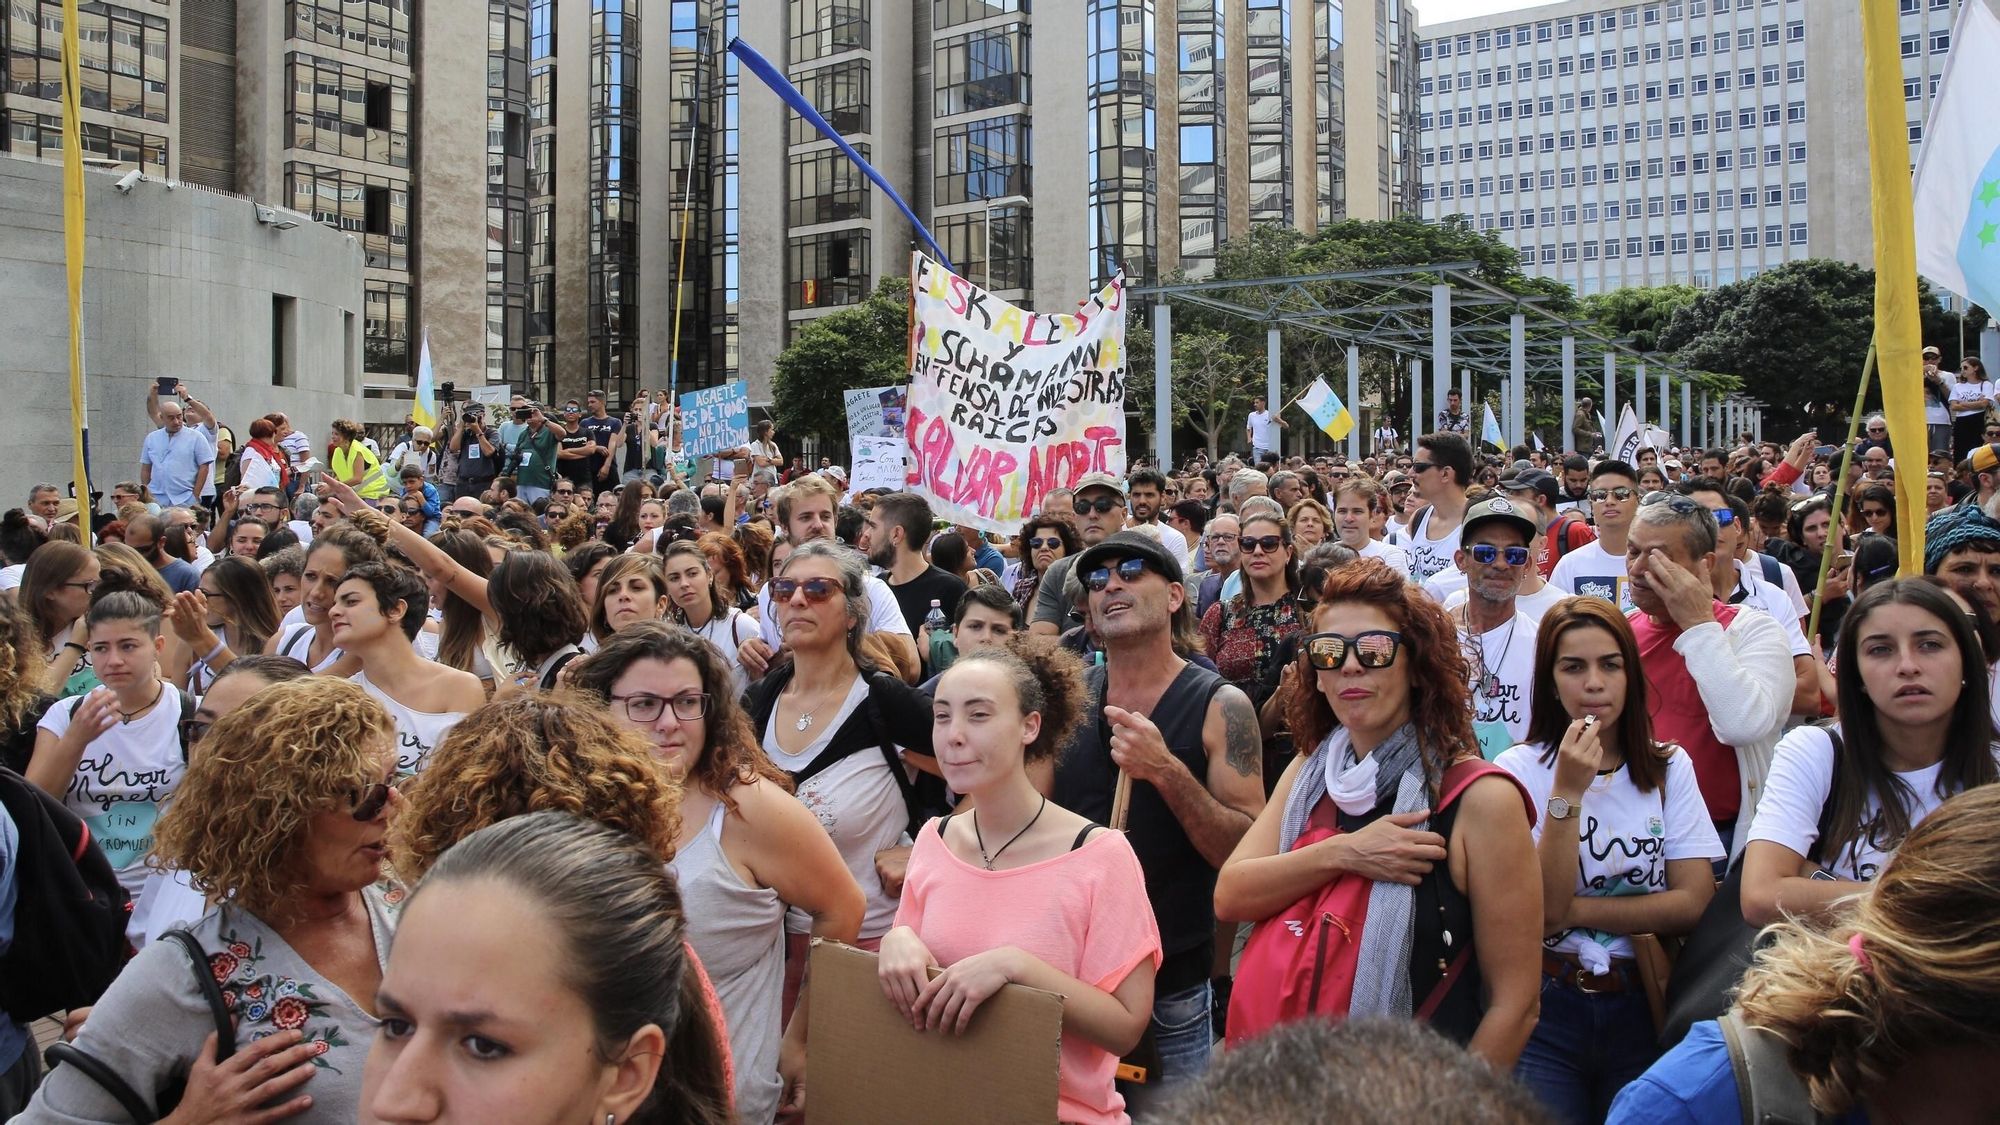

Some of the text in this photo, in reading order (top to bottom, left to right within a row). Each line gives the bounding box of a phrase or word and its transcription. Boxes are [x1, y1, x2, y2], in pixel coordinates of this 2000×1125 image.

[696, 383, 738, 407] AGAETE
[846, 390, 871, 408] AGAETE
[1007, 392, 1035, 419] DE
[681, 395, 748, 430] ES DE TODOS
[699, 418, 732, 437] NO DEL
[684, 426, 750, 457] CAPITALISMO
[905, 406, 1018, 519] SALVAR
